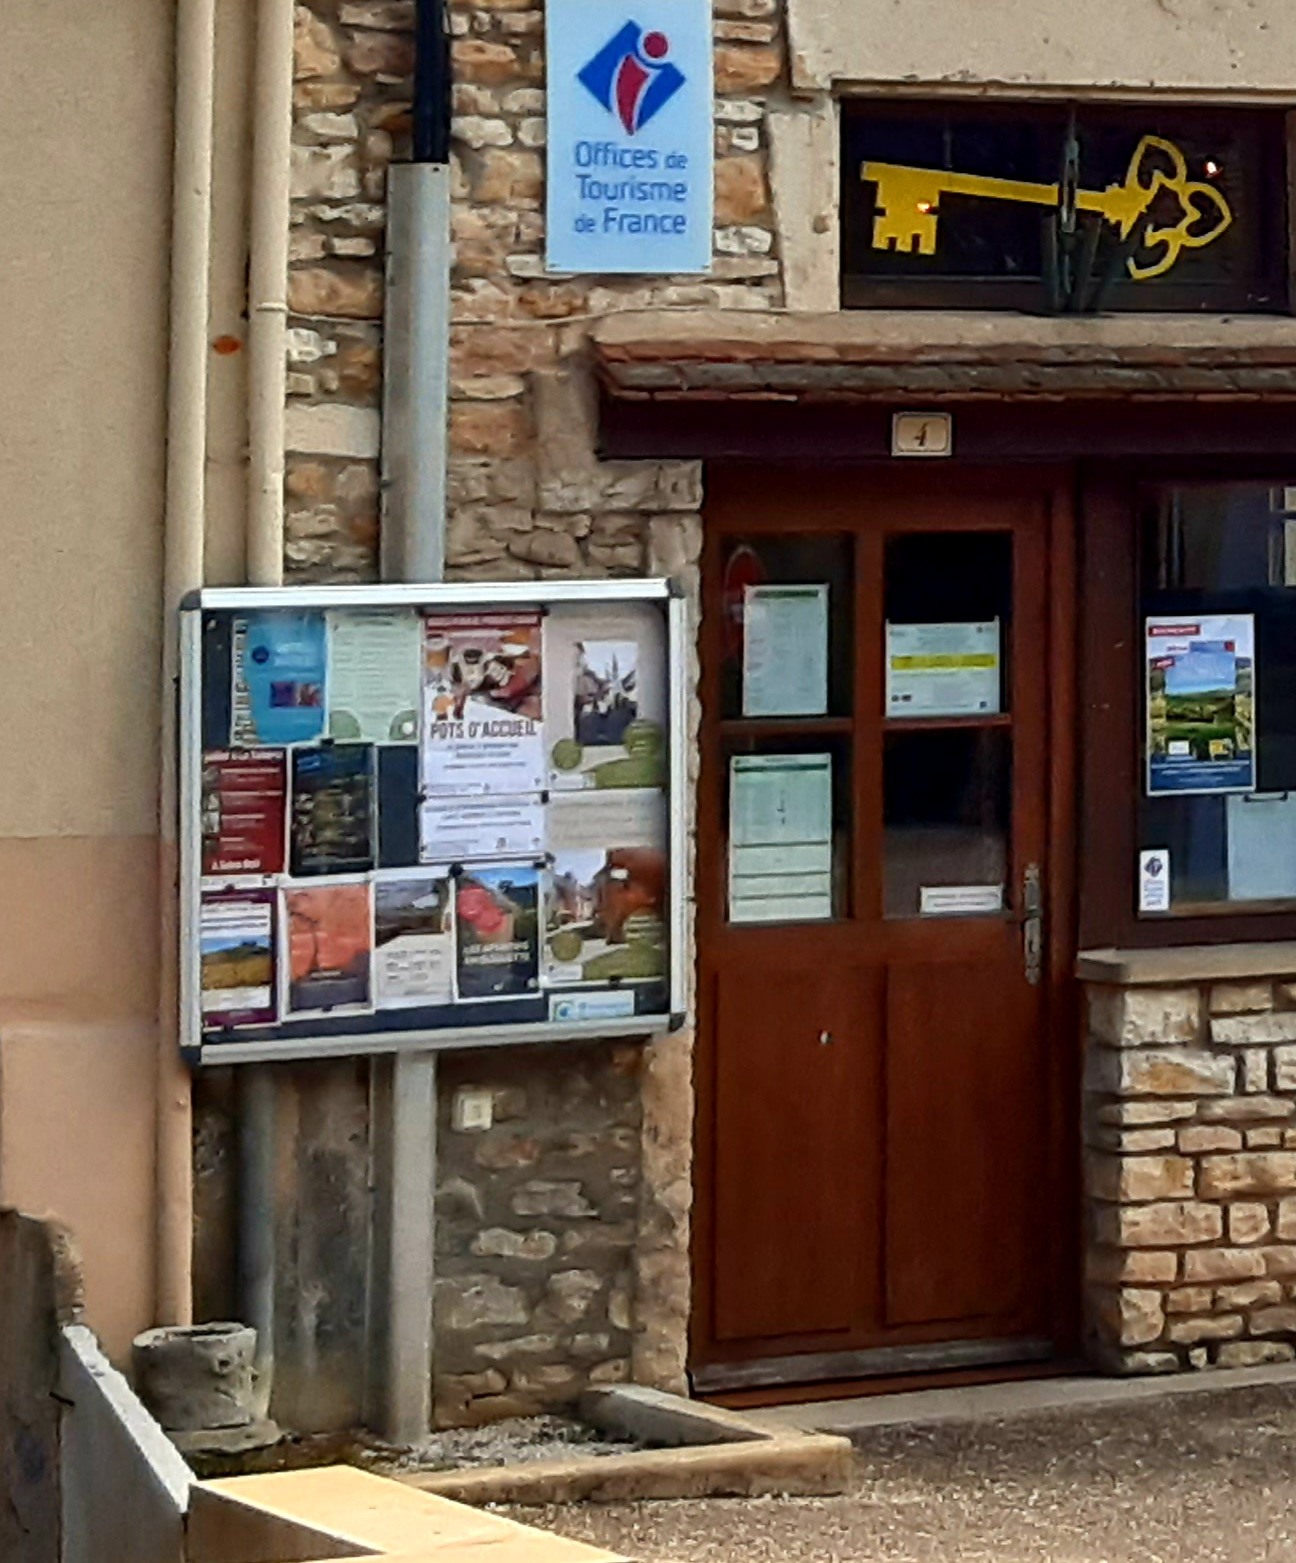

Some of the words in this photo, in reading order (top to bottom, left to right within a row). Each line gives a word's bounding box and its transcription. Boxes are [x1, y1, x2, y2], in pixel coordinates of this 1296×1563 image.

[575, 141, 658, 169] Offices
[664, 151, 688, 169] de
[575, 174, 688, 202] Tourisme
[574, 213, 596, 233] de
[603, 207, 686, 234] France
[430, 723, 465, 738] POTS
